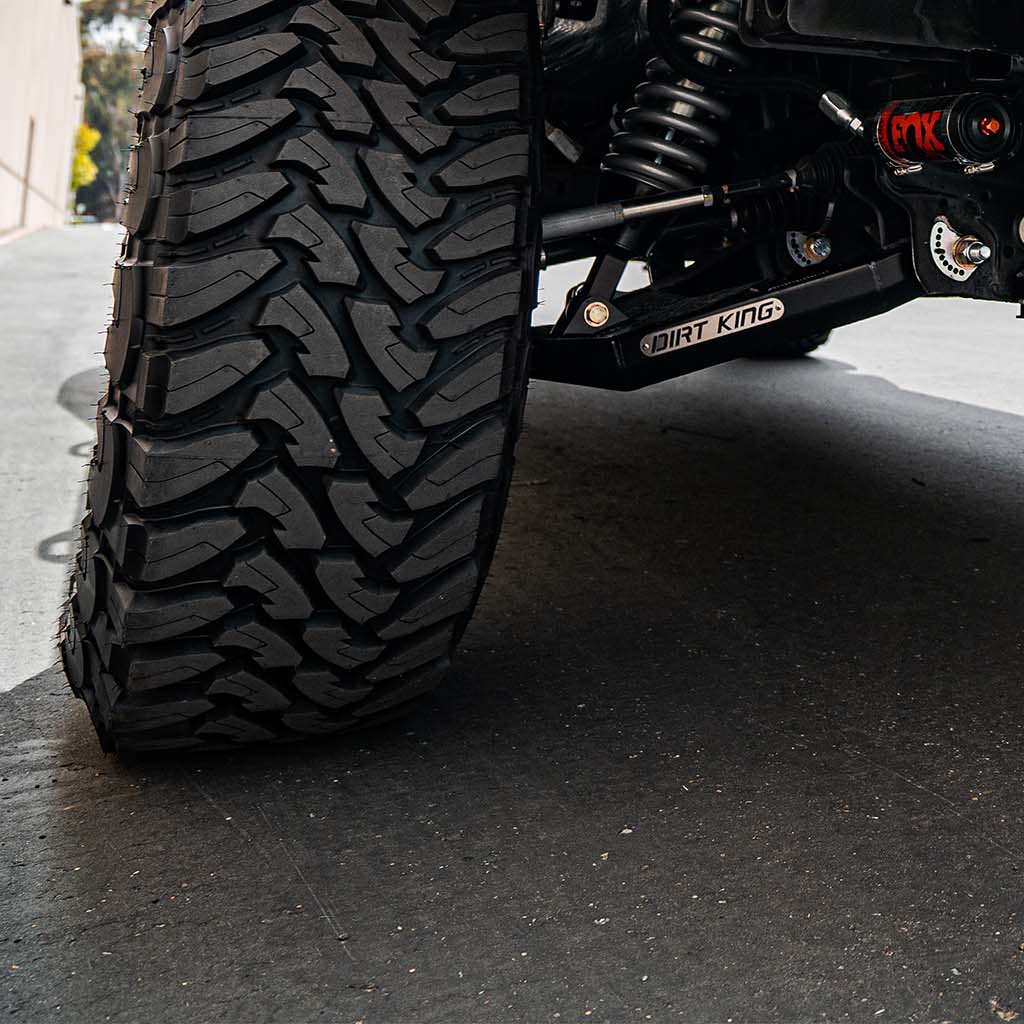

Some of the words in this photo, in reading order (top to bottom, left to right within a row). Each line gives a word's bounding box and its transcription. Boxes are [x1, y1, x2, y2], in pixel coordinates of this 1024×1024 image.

[890, 111, 946, 153] FOX
[651, 320, 709, 354] DIRT
[717, 301, 774, 334] KING
